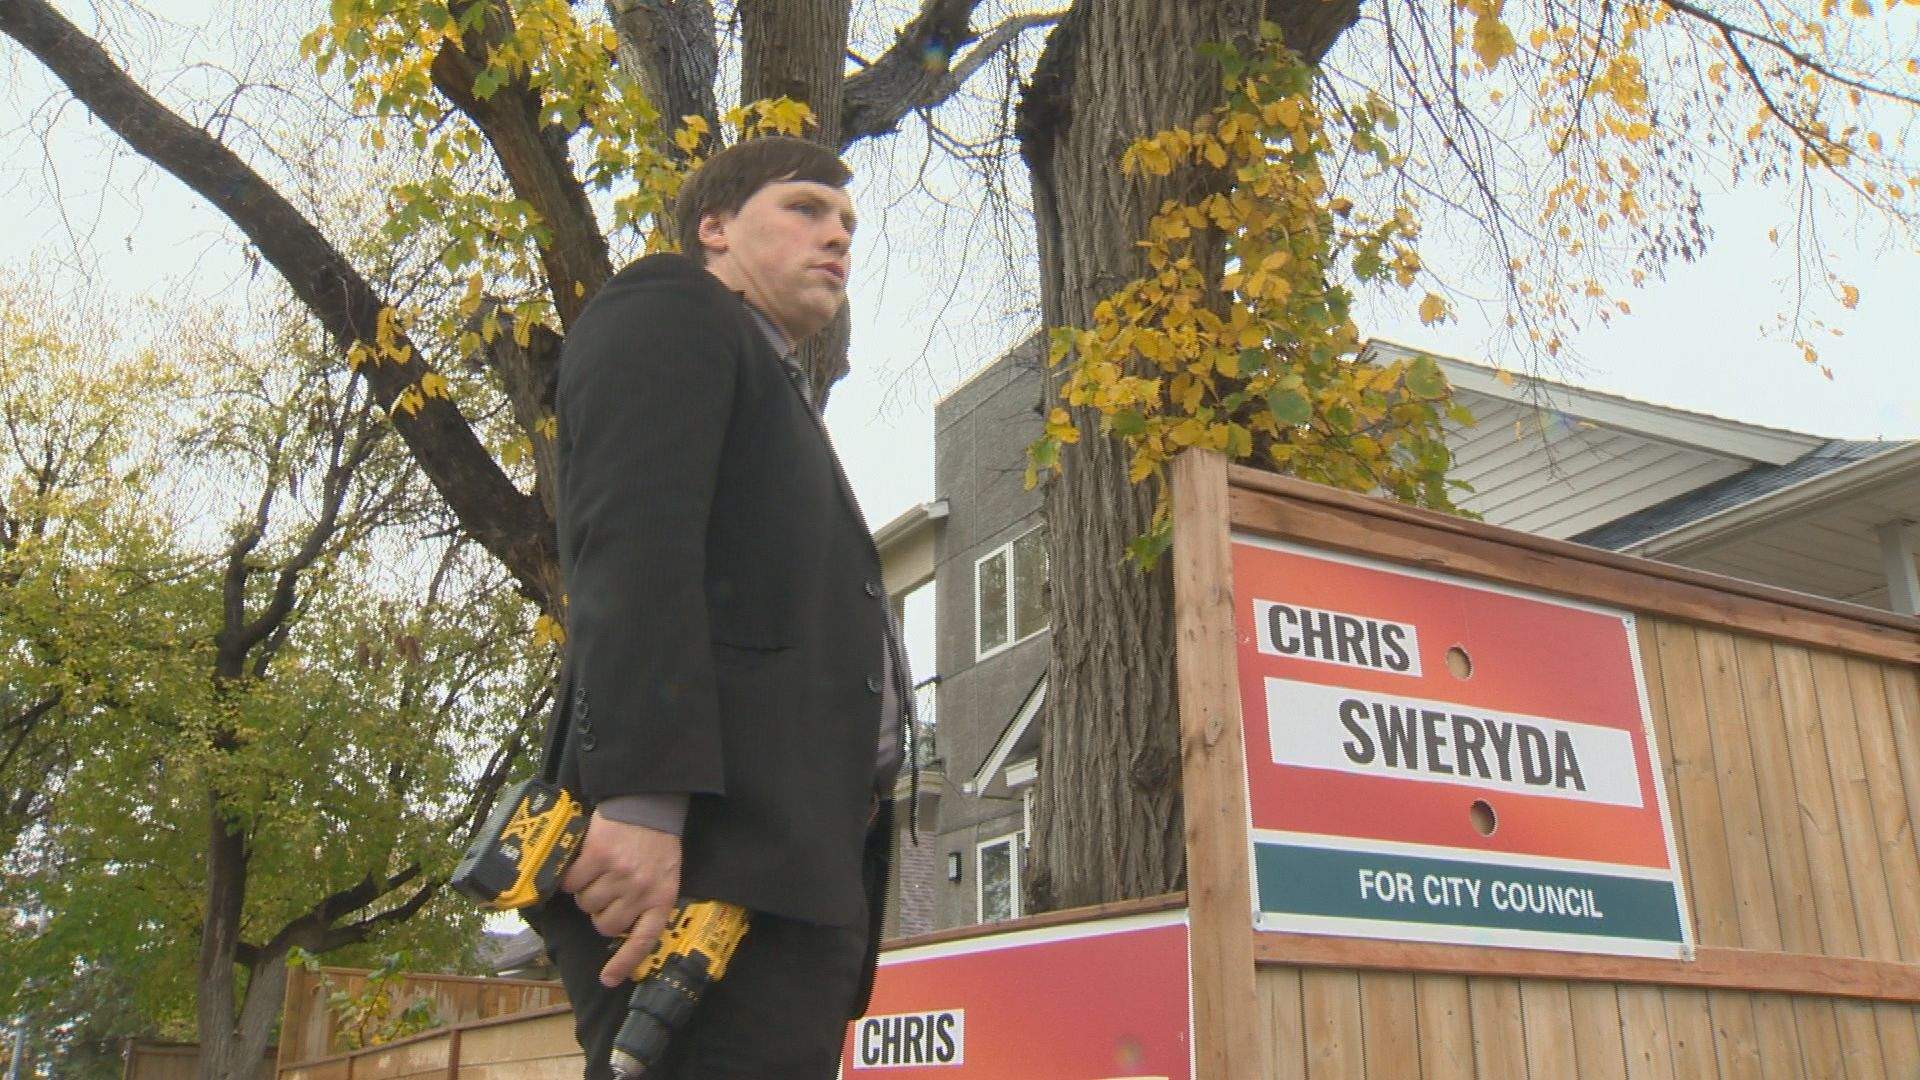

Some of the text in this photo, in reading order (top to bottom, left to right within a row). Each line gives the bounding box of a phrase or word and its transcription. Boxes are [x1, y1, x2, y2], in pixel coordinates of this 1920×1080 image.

[1268, 605, 1411, 672] CHRIS
[1338, 699, 1587, 792] SWERYDA
[1359, 869, 1603, 918] FOR CITY COUNCIL
[862, 1013, 956, 1065] CHRIS
